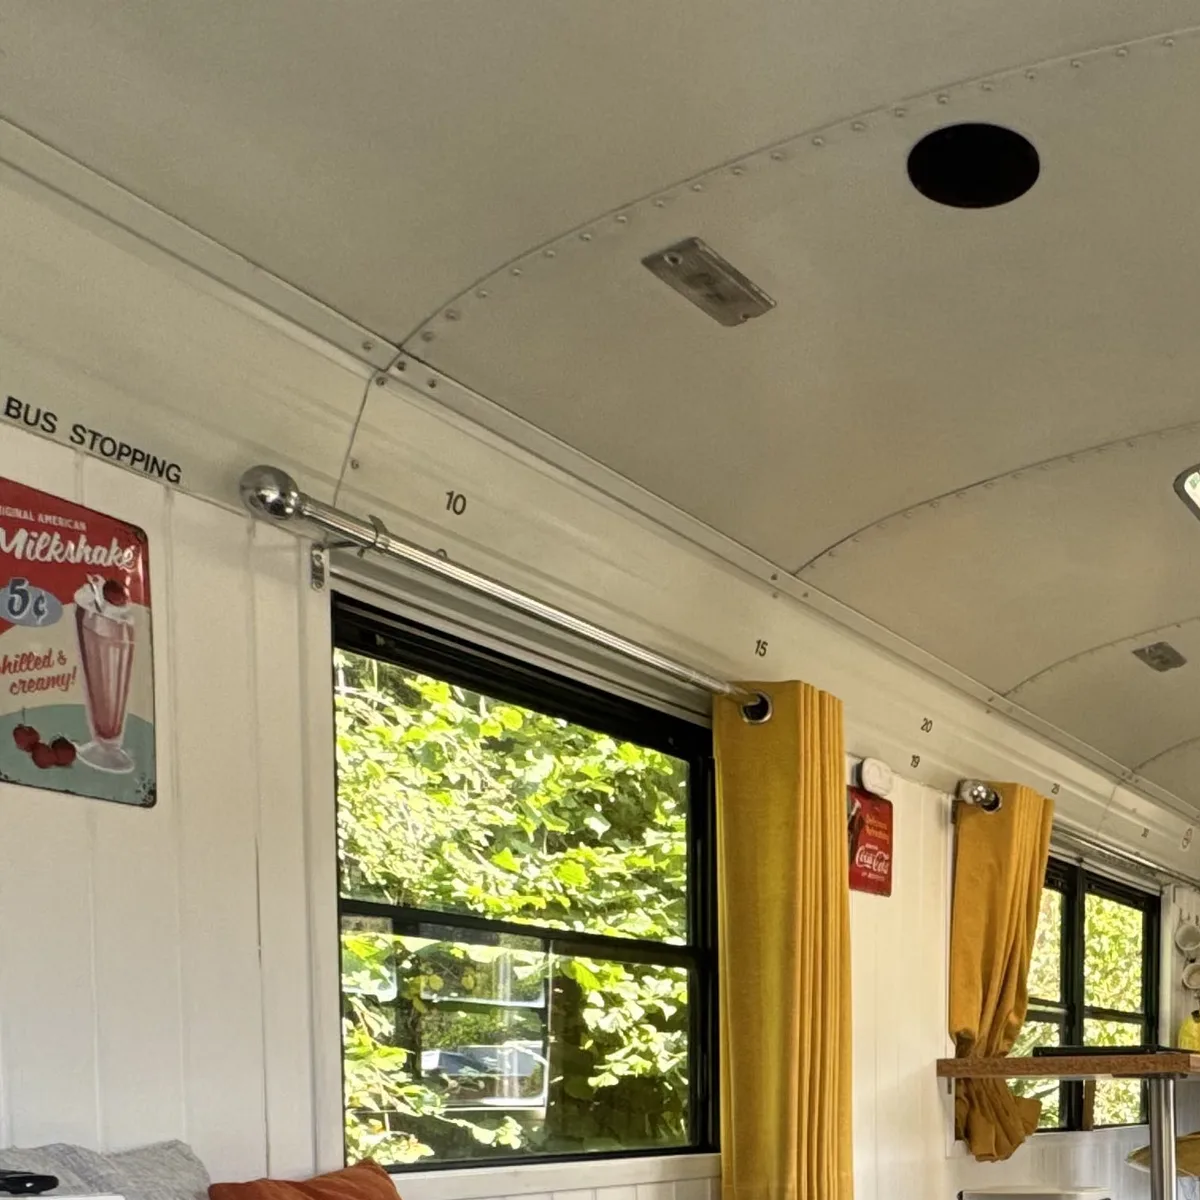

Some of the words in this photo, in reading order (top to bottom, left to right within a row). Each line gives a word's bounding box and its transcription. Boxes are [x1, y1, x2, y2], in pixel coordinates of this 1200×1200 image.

[4, 395, 58, 434] BUS
[69, 424, 182, 484] STOPPING
[446, 490, 467, 516] 10
[38, 512, 87, 532] AMERICAN
[0, 527, 136, 573] Milkshake
[0, 647, 55, 675] hilled
[57, 649, 68, 666] &
[754, 639, 768, 658] 15
[9, 665, 77, 696] creamy!
[920, 717, 933, 734] 20
[910, 754, 921, 769] 19
